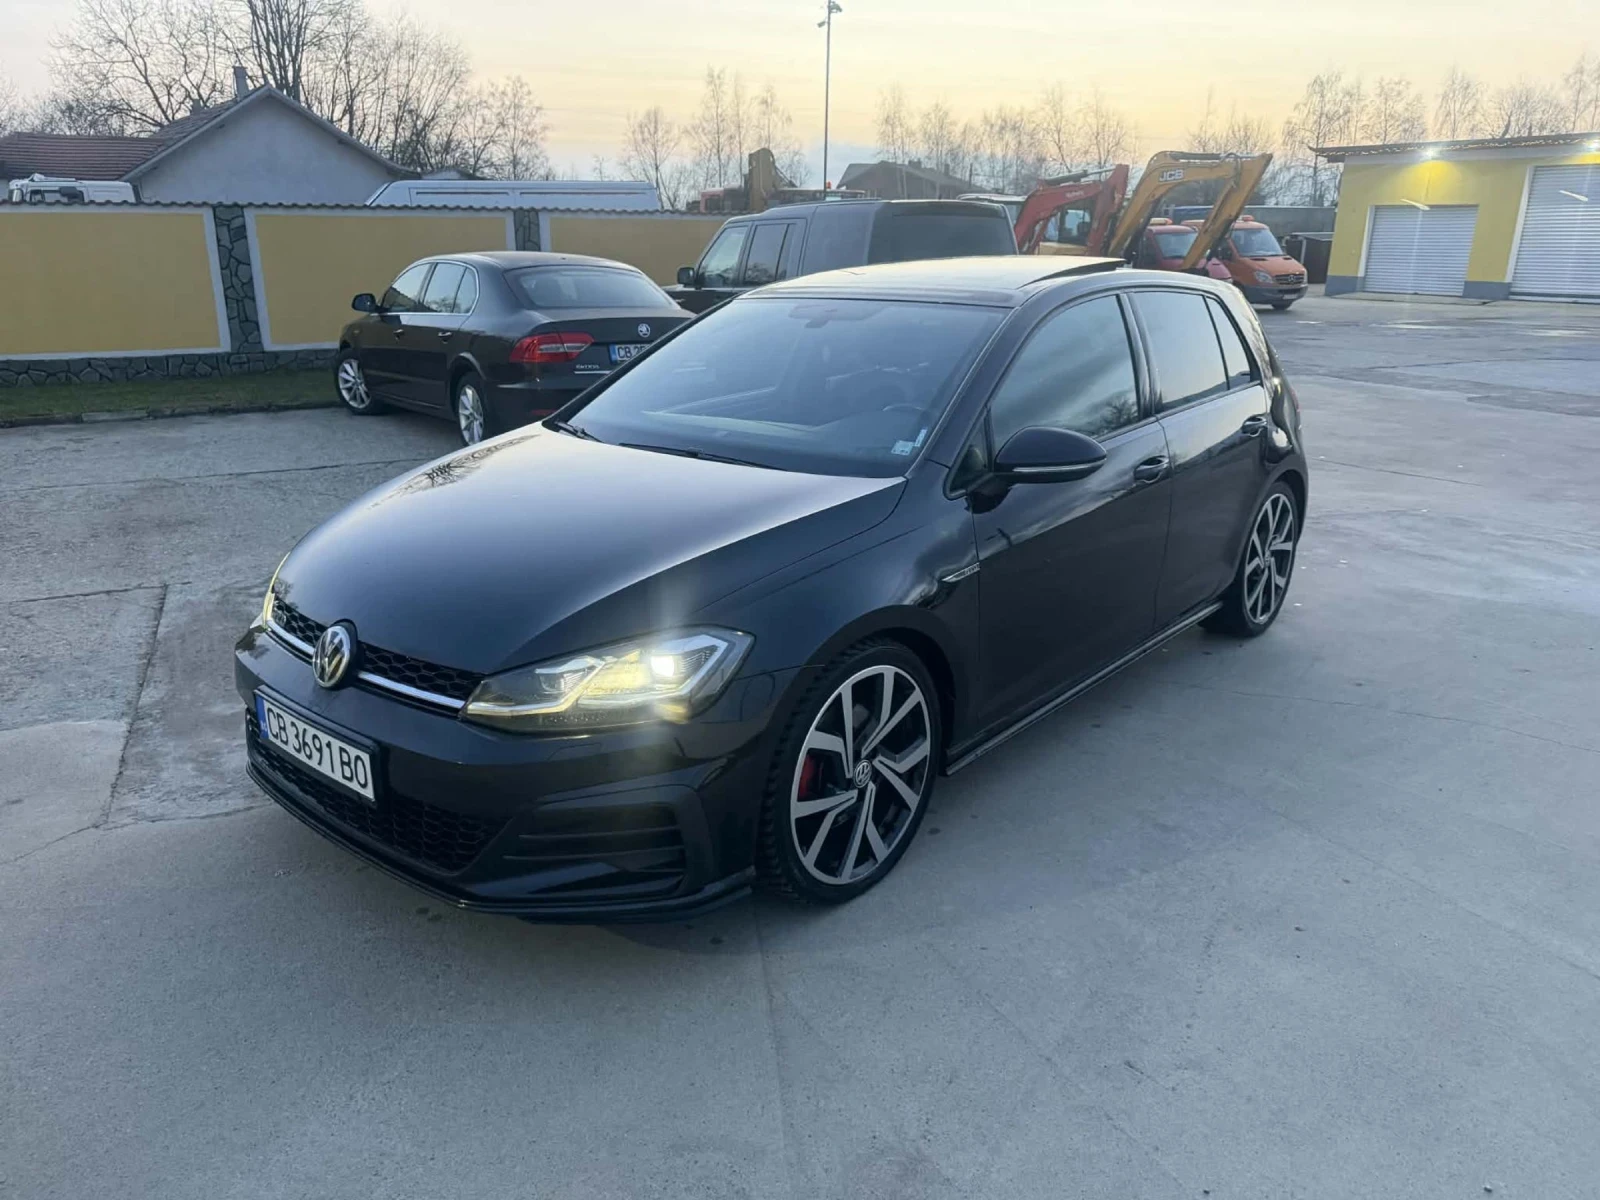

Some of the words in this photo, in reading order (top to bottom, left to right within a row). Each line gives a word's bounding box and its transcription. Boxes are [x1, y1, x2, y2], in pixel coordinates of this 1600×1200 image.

[1159, 169, 1184, 182] JCB
[267, 707, 289, 746] CB
[290, 721, 335, 774] 3691
